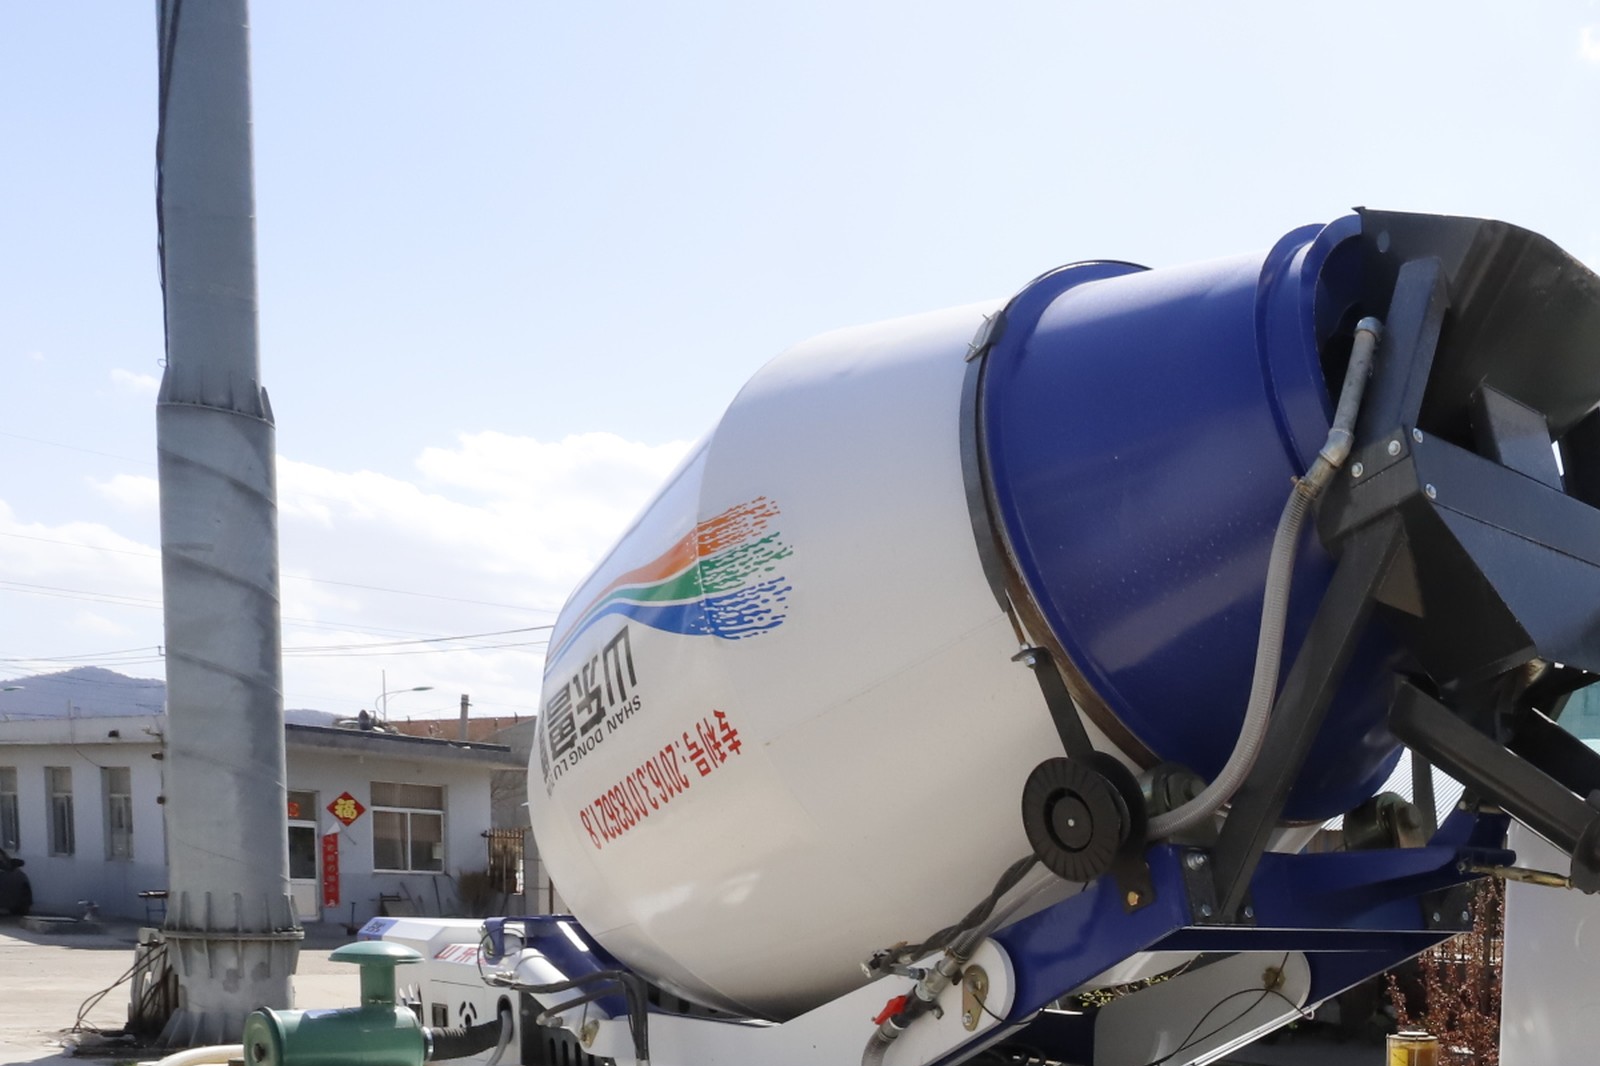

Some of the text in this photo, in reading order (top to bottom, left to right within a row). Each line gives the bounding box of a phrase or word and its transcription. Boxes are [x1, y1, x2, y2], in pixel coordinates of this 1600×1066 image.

[552, 695, 641, 781] SHAN DONG LU
[334, 798, 358, 820] 福
